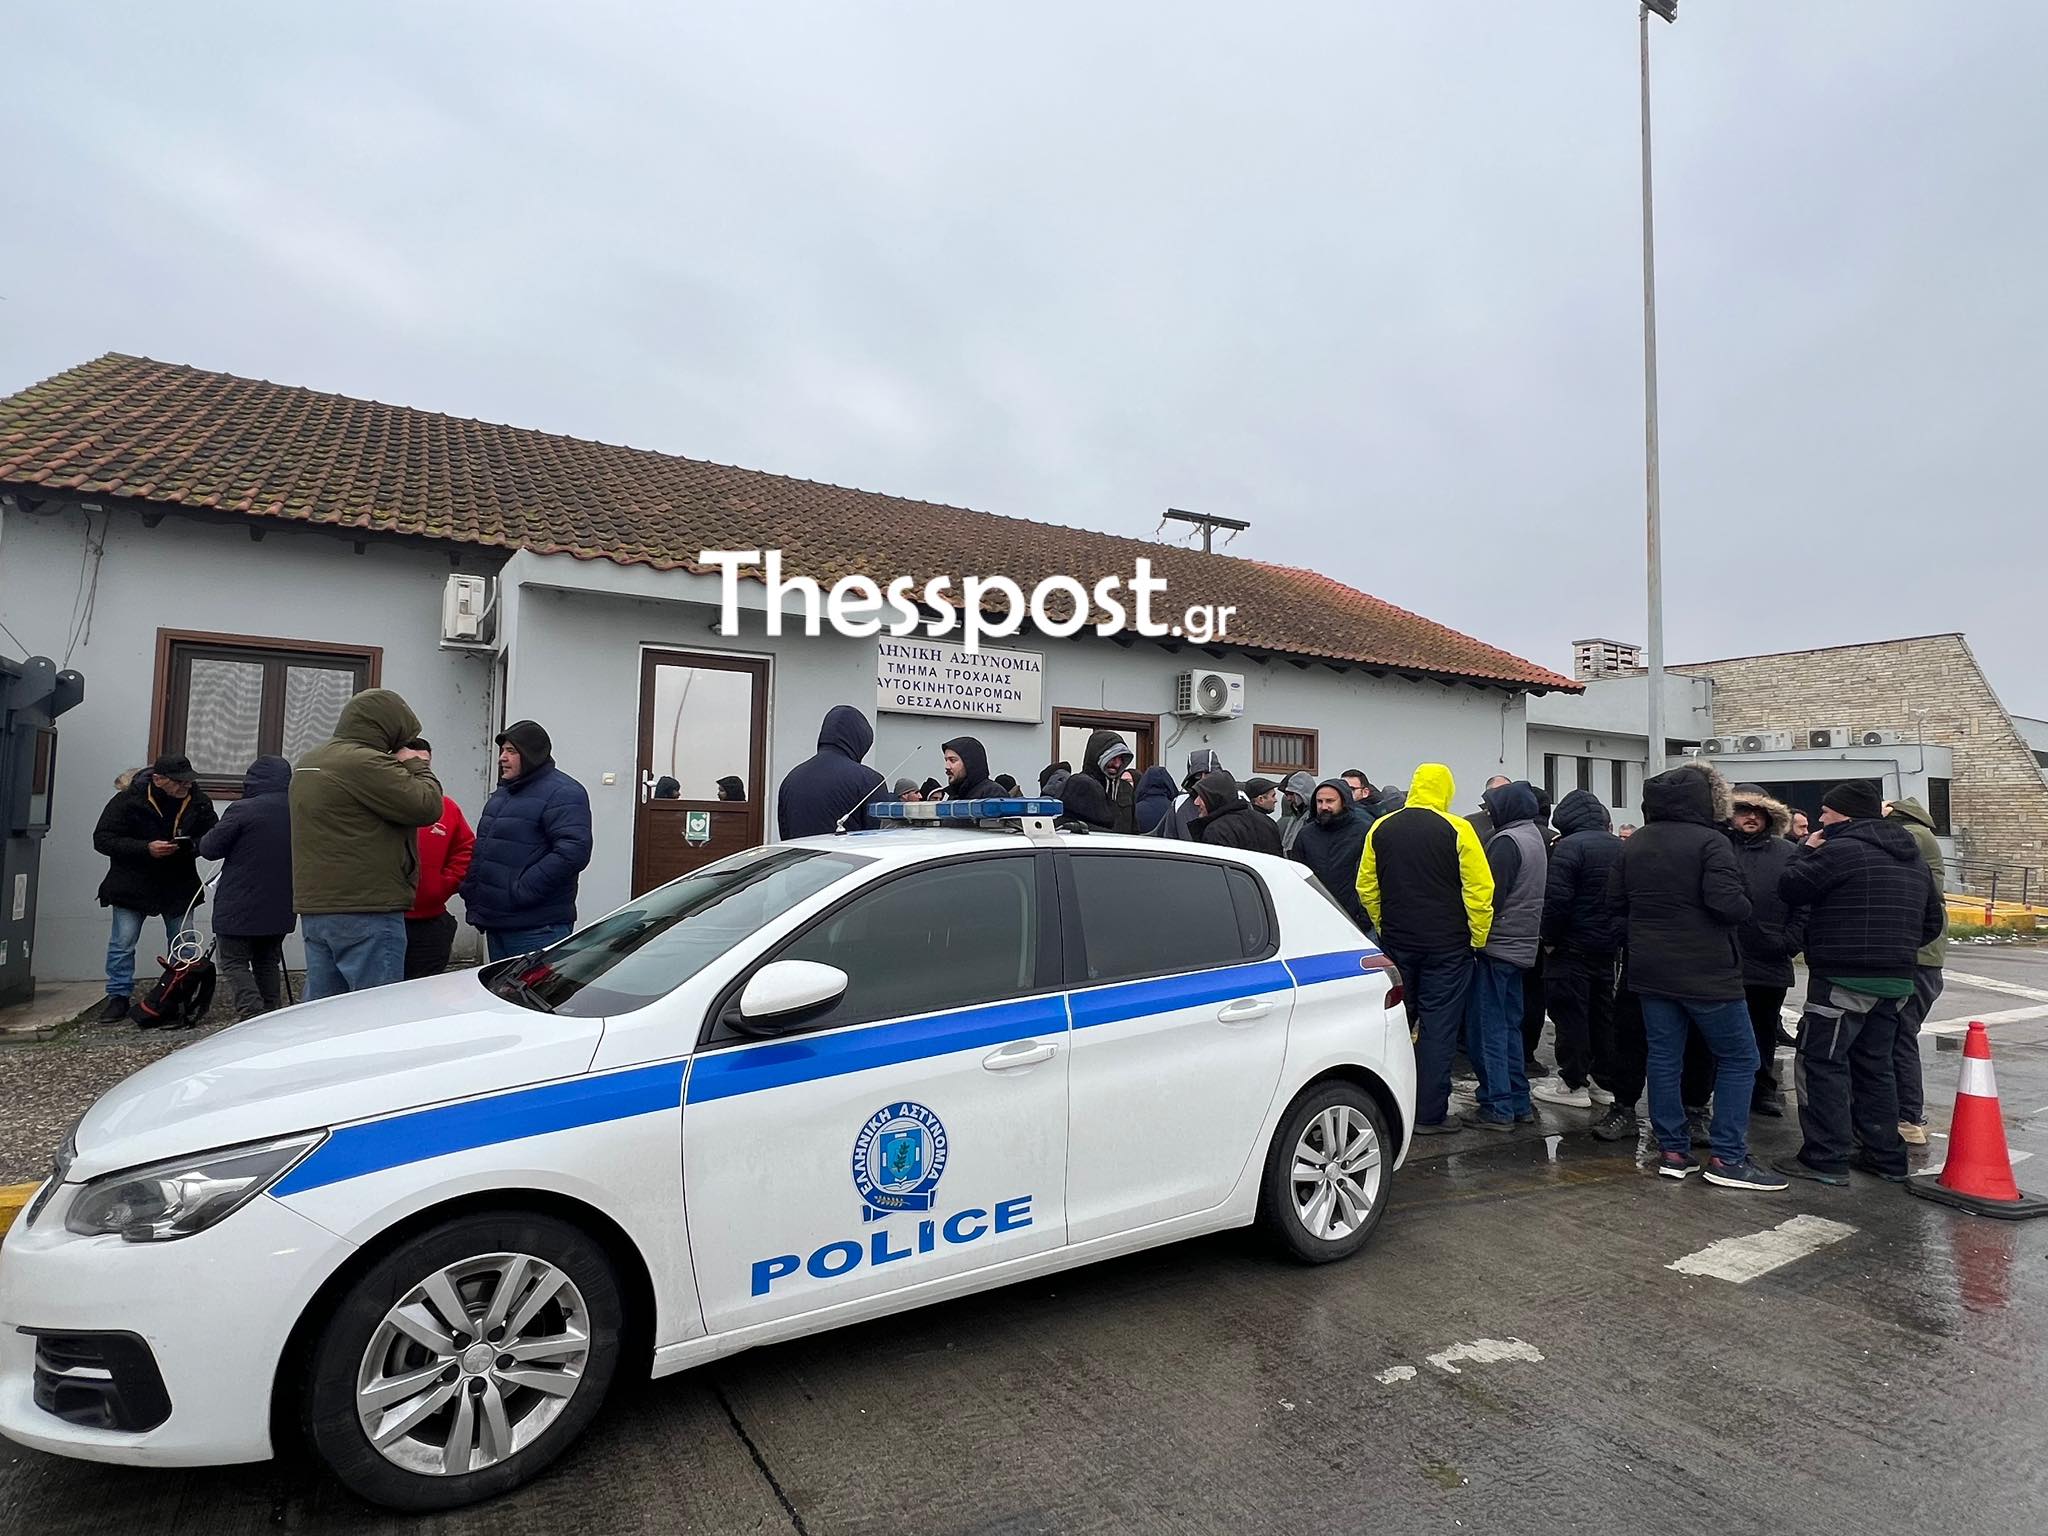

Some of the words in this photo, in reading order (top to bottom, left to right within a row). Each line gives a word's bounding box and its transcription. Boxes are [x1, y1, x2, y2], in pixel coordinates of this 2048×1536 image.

[887, 662, 938, 678] ΤΜΗΜΑ
[945, 668, 1012, 685] ΤΡΟΧΑΙΑΣ
[950, 652, 1041, 673] ΑΣΤΥΝΟΜΙΑ
[896, 694, 1003, 714] ΘΕΣΣΑΛΟΝΙΚΗΣ
[854, 1107, 892, 1196] ΕΛΛΗΝΙΚΗ
[899, 1103, 946, 1180] ΑΣΤΥΝΟΜΙΑ
[751, 1194, 1033, 1297] POLICE
